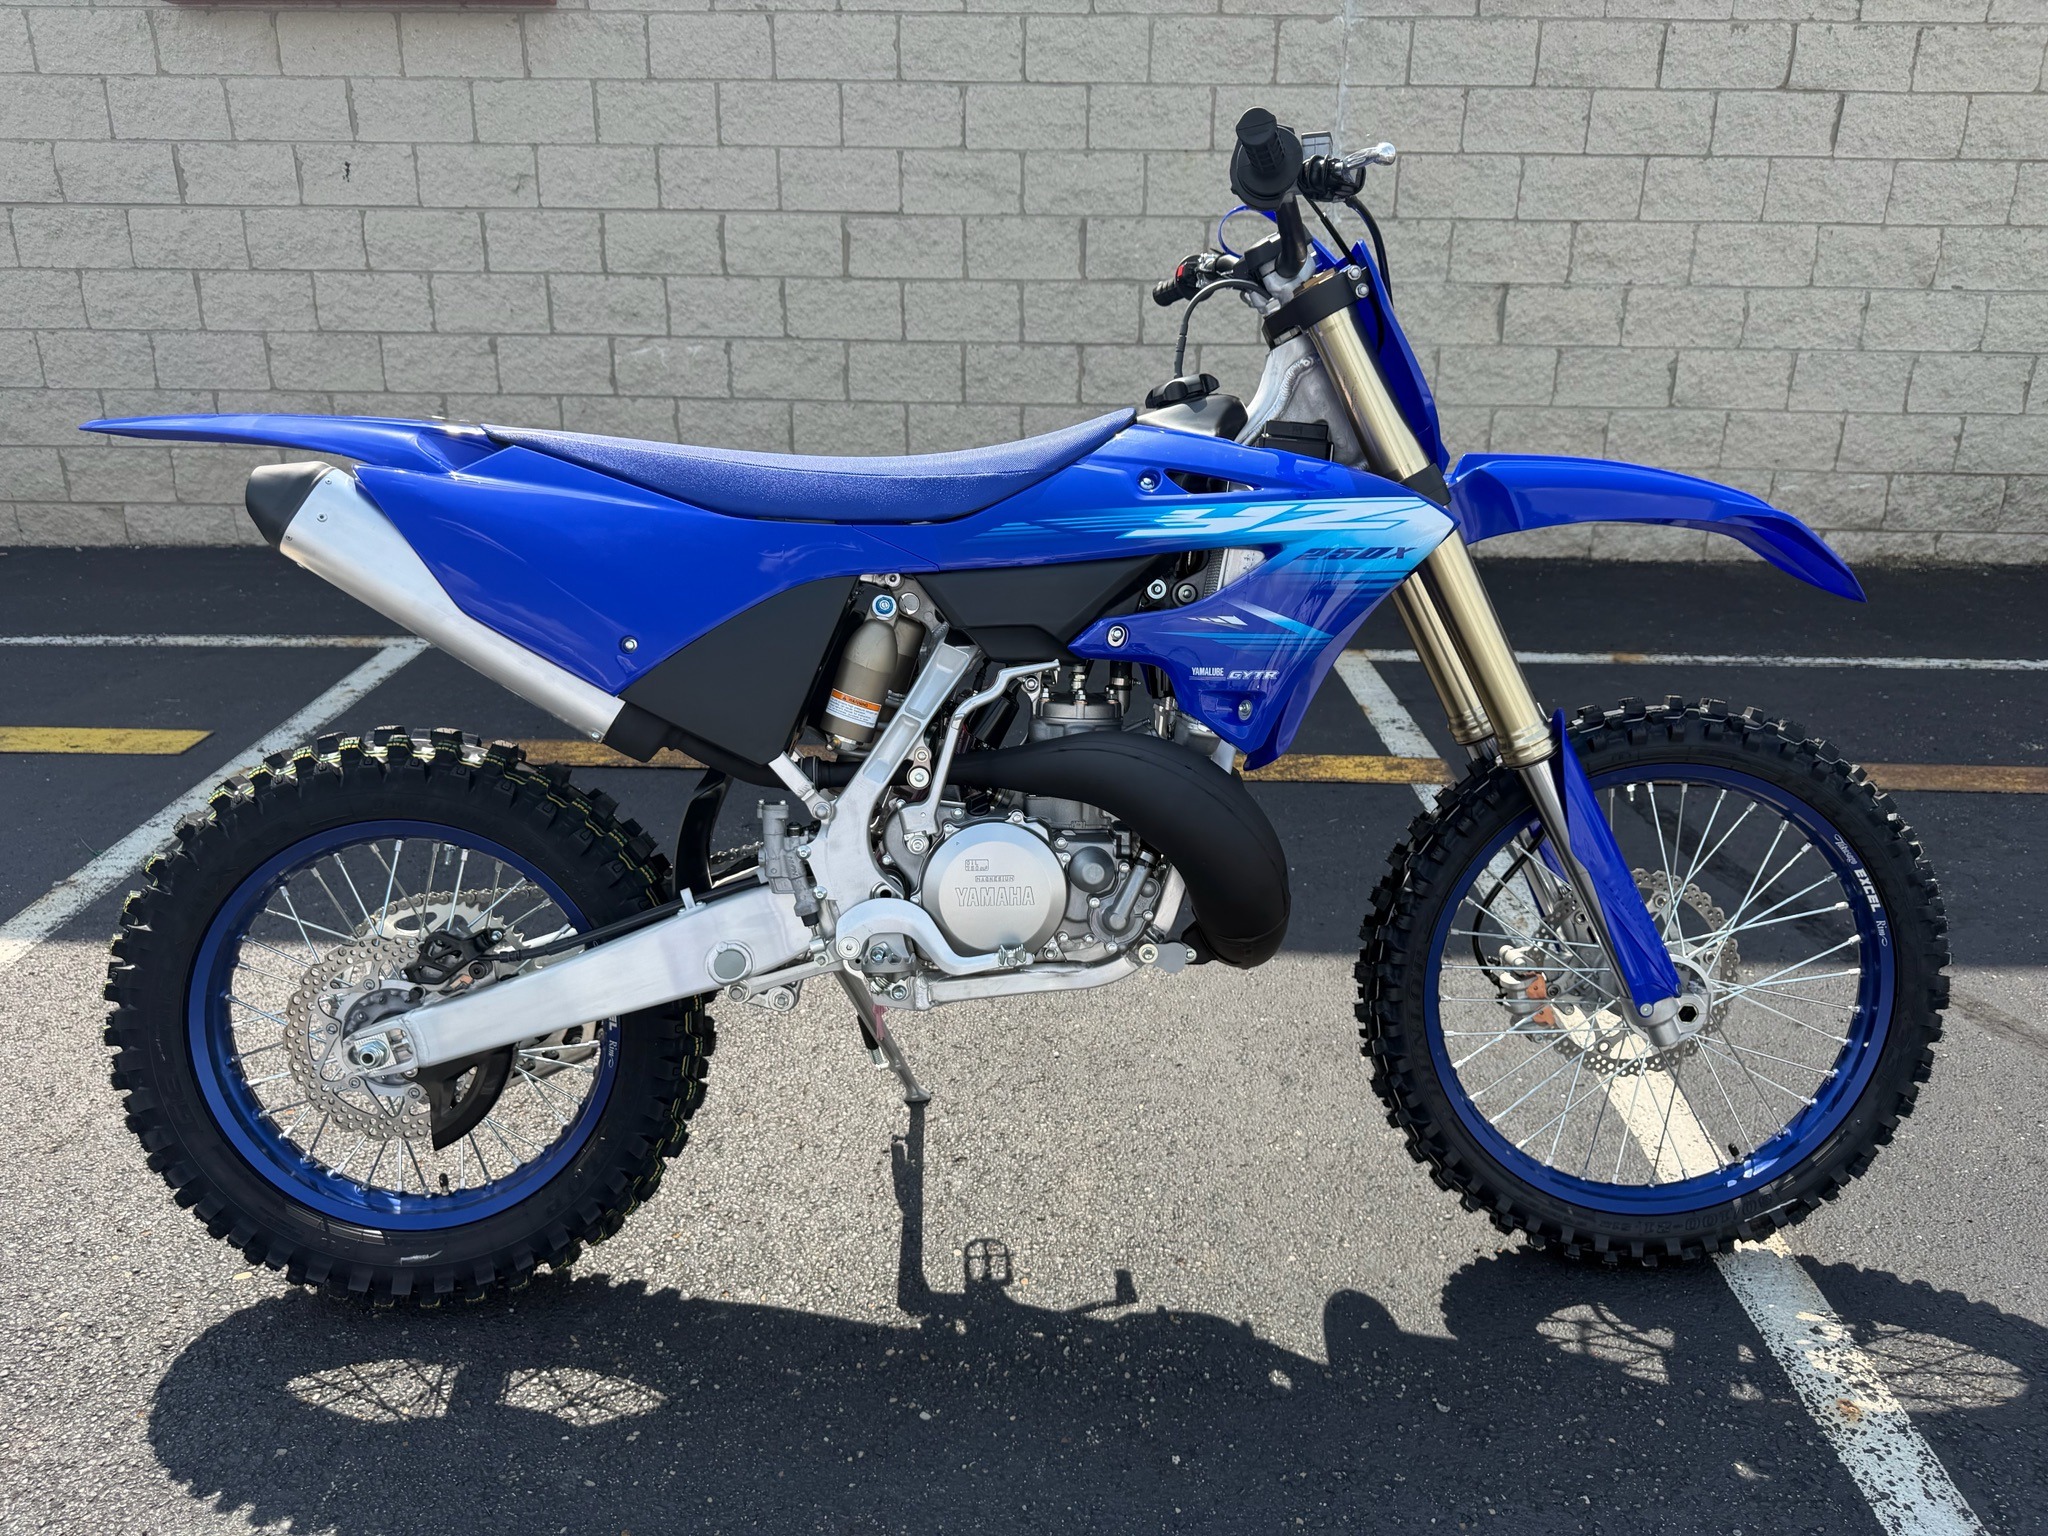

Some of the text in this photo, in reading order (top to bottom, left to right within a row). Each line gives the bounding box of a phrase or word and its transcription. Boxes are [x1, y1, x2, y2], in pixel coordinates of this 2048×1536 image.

[1299, 546, 1417, 560] 250X
[1191, 667, 1224, 676] YAMALUBE
[1227, 670, 1280, 680] GYTR
[955, 886, 1035, 907] YAMAHA
[1853, 867, 1882, 913] EXCEL
